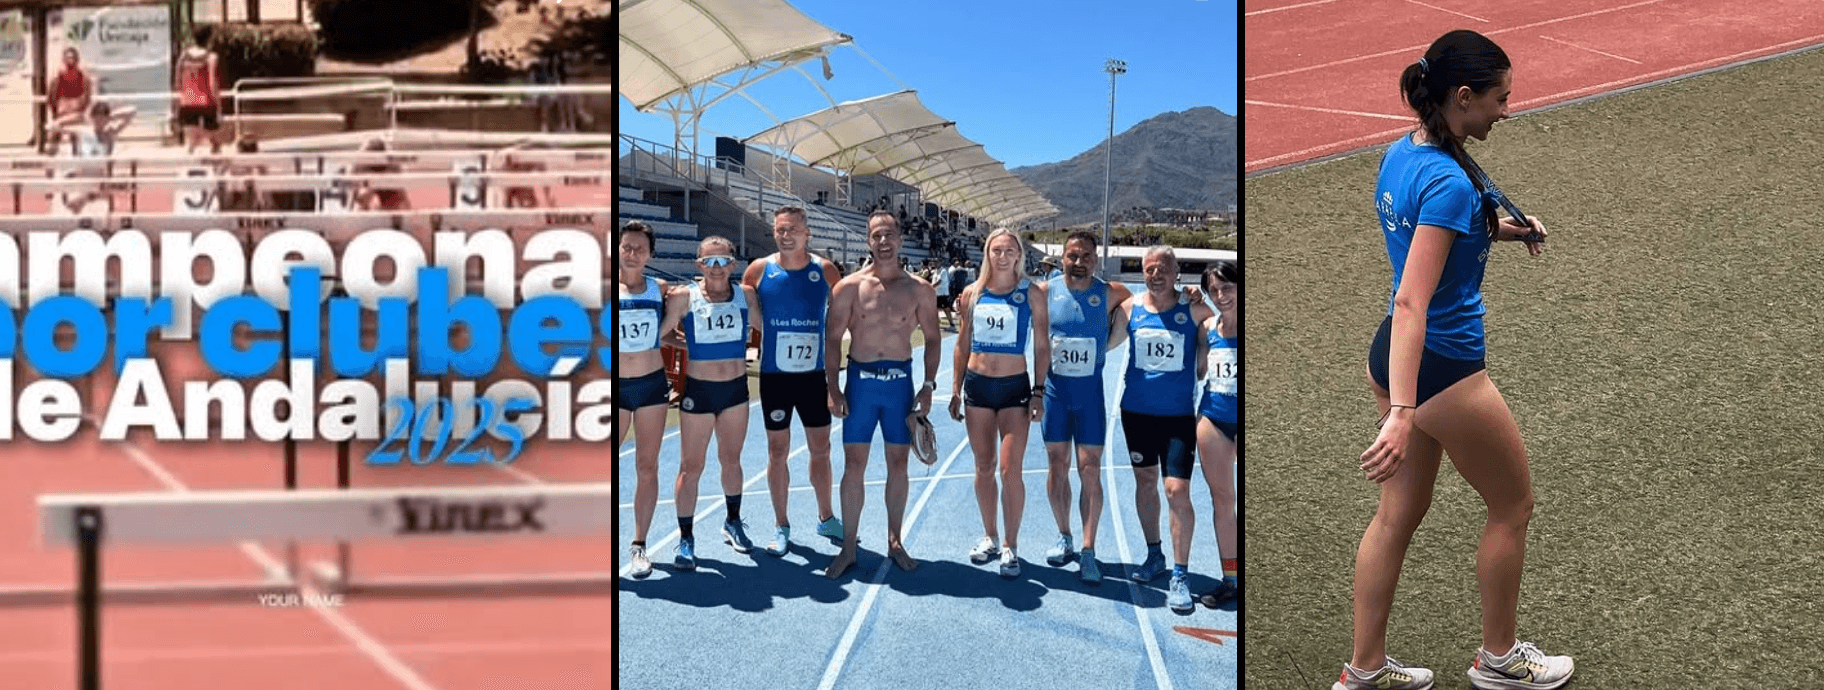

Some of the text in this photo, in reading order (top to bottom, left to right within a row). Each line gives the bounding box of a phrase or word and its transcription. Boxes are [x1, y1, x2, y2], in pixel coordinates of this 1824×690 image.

[621, 322, 650, 338] 137
[706, 314, 735, 331] 142
[986, 316, 1005, 330] 94
[787, 345, 812, 359] 172
[1060, 350, 1089, 364] 304
[1146, 342, 1175, 358] 182
